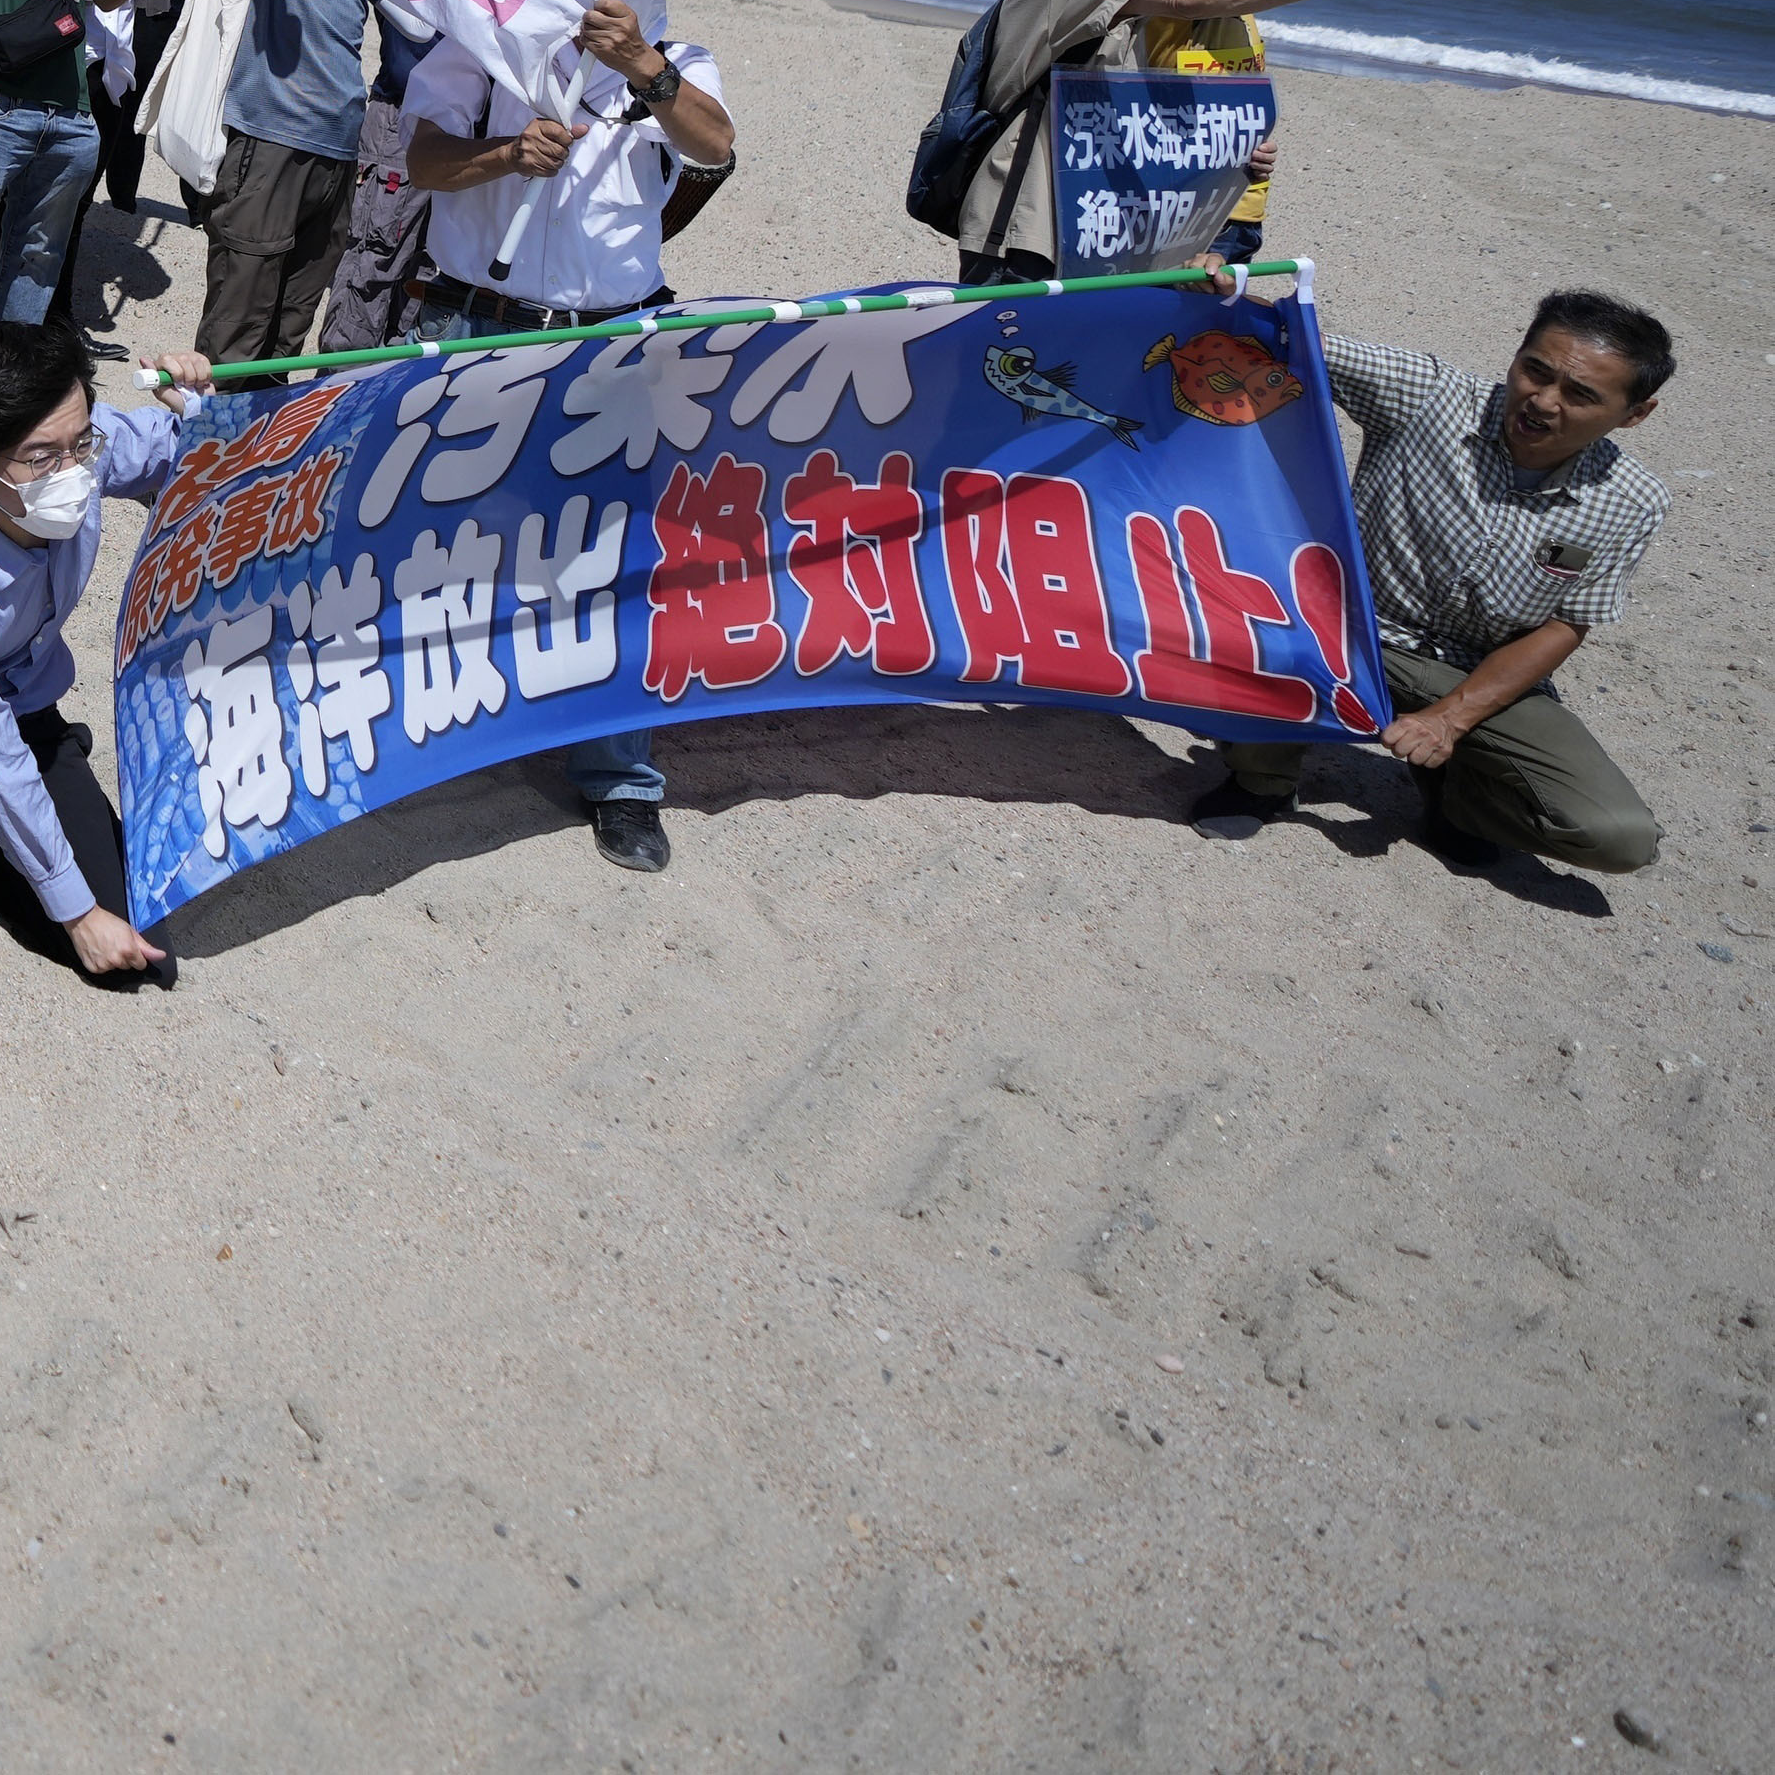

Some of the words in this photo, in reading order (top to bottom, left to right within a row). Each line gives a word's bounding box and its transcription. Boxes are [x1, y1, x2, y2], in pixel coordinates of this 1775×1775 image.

[1064, 102, 1266, 169] 汚染水海洋放出
[358, 297, 993, 529] 汚染水
[116, 445, 343, 679] 原発事故
